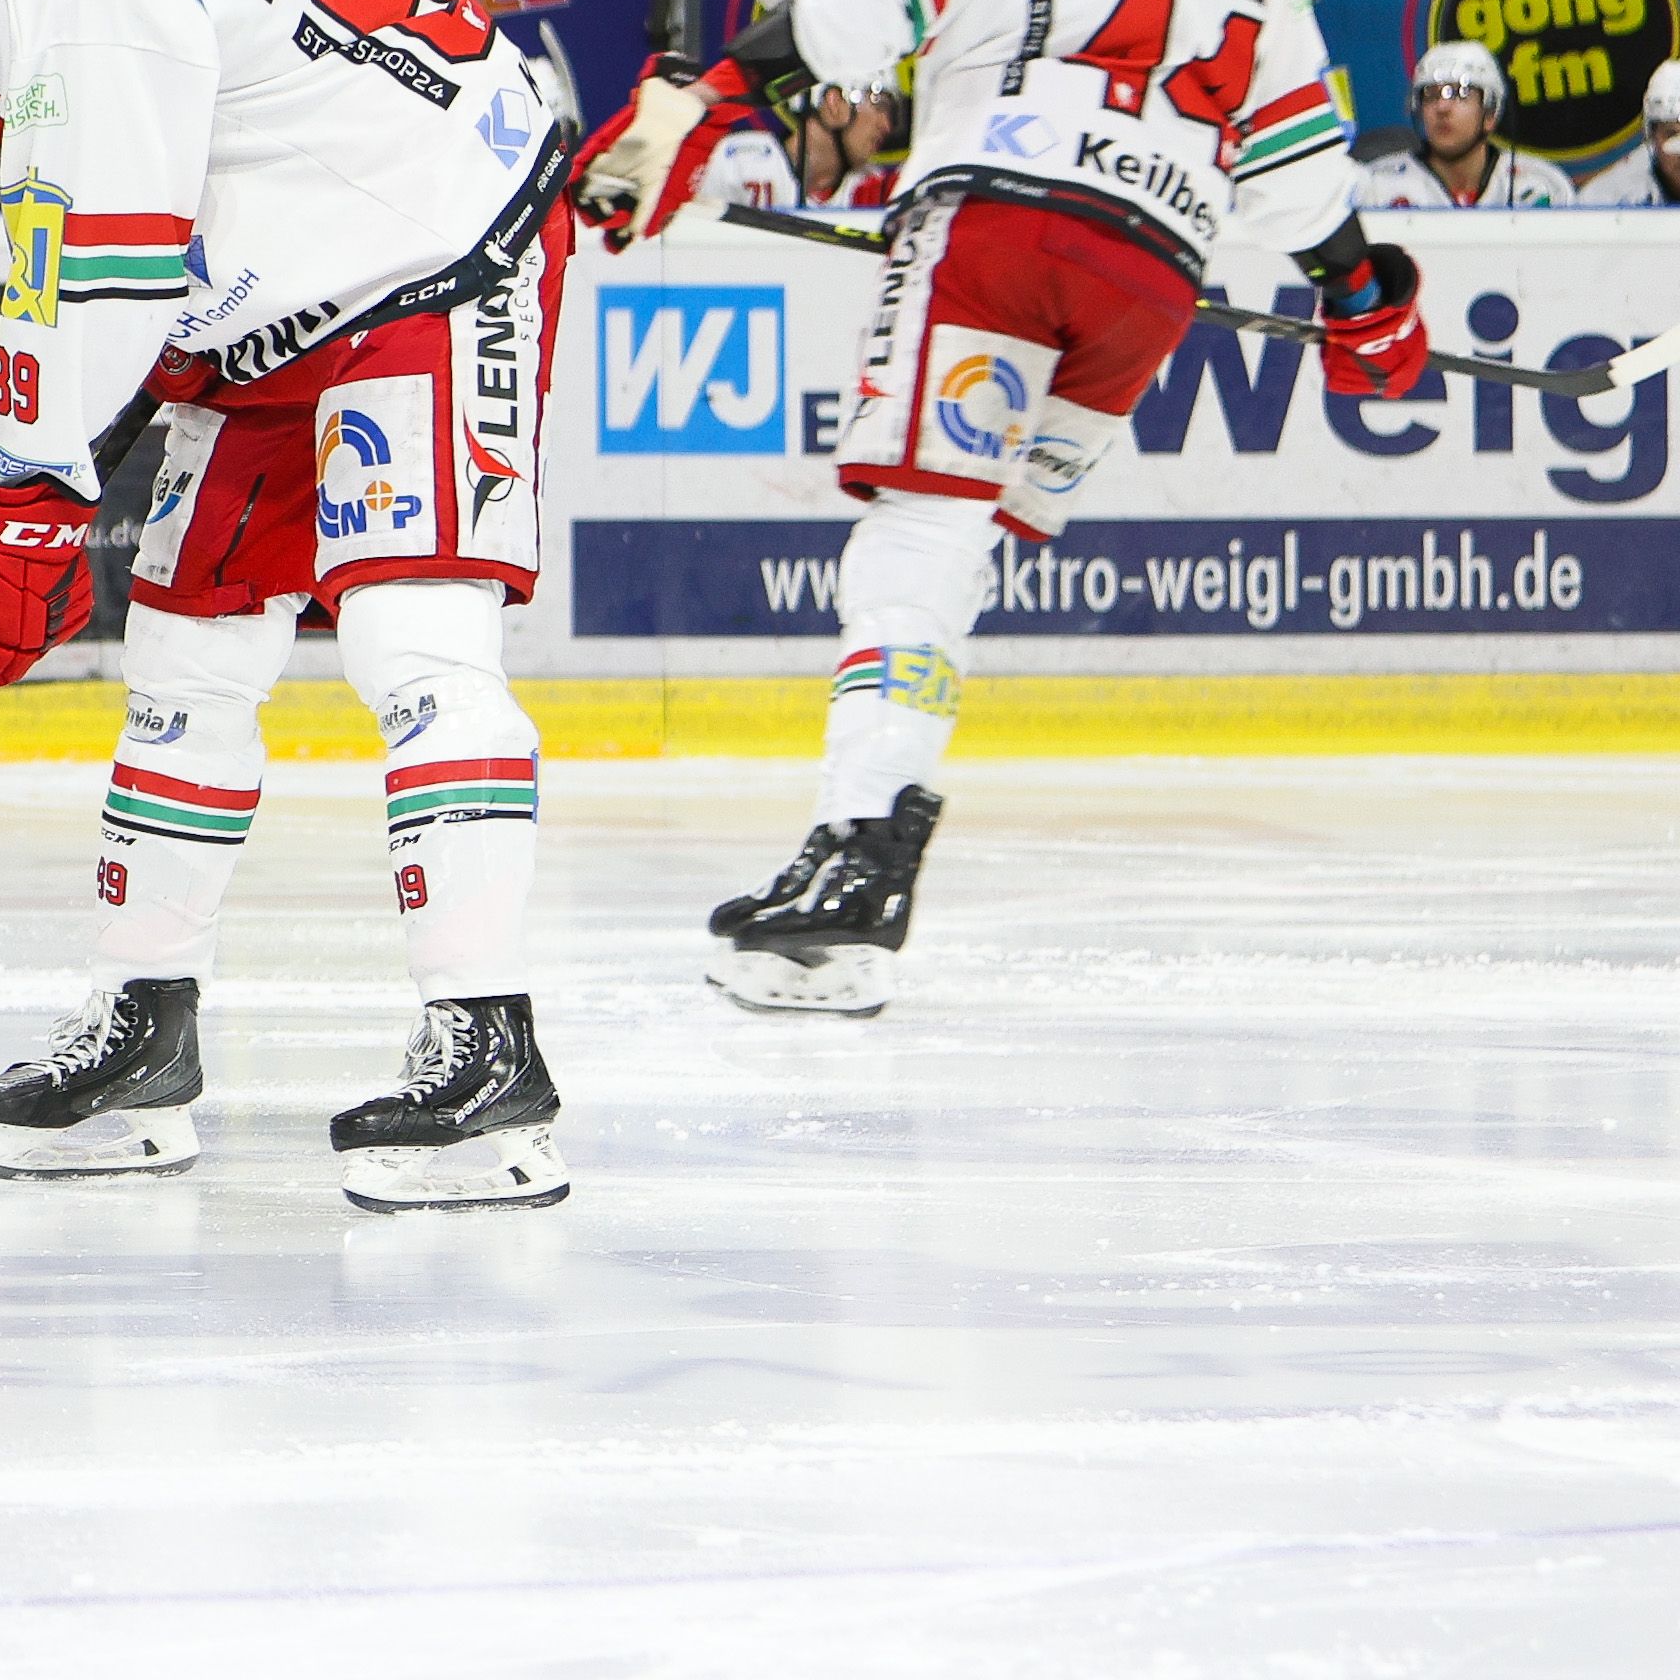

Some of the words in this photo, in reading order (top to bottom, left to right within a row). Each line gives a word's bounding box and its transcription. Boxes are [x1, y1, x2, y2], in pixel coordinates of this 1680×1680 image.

[1507, 39, 1613, 107] fm
[206, 266, 260, 320] GmbH
[398, 276, 458, 307] CCM
[603, 307, 777, 431] WJ
[389, 832, 422, 855] CM
[453, 1076, 500, 1126] BAUER
